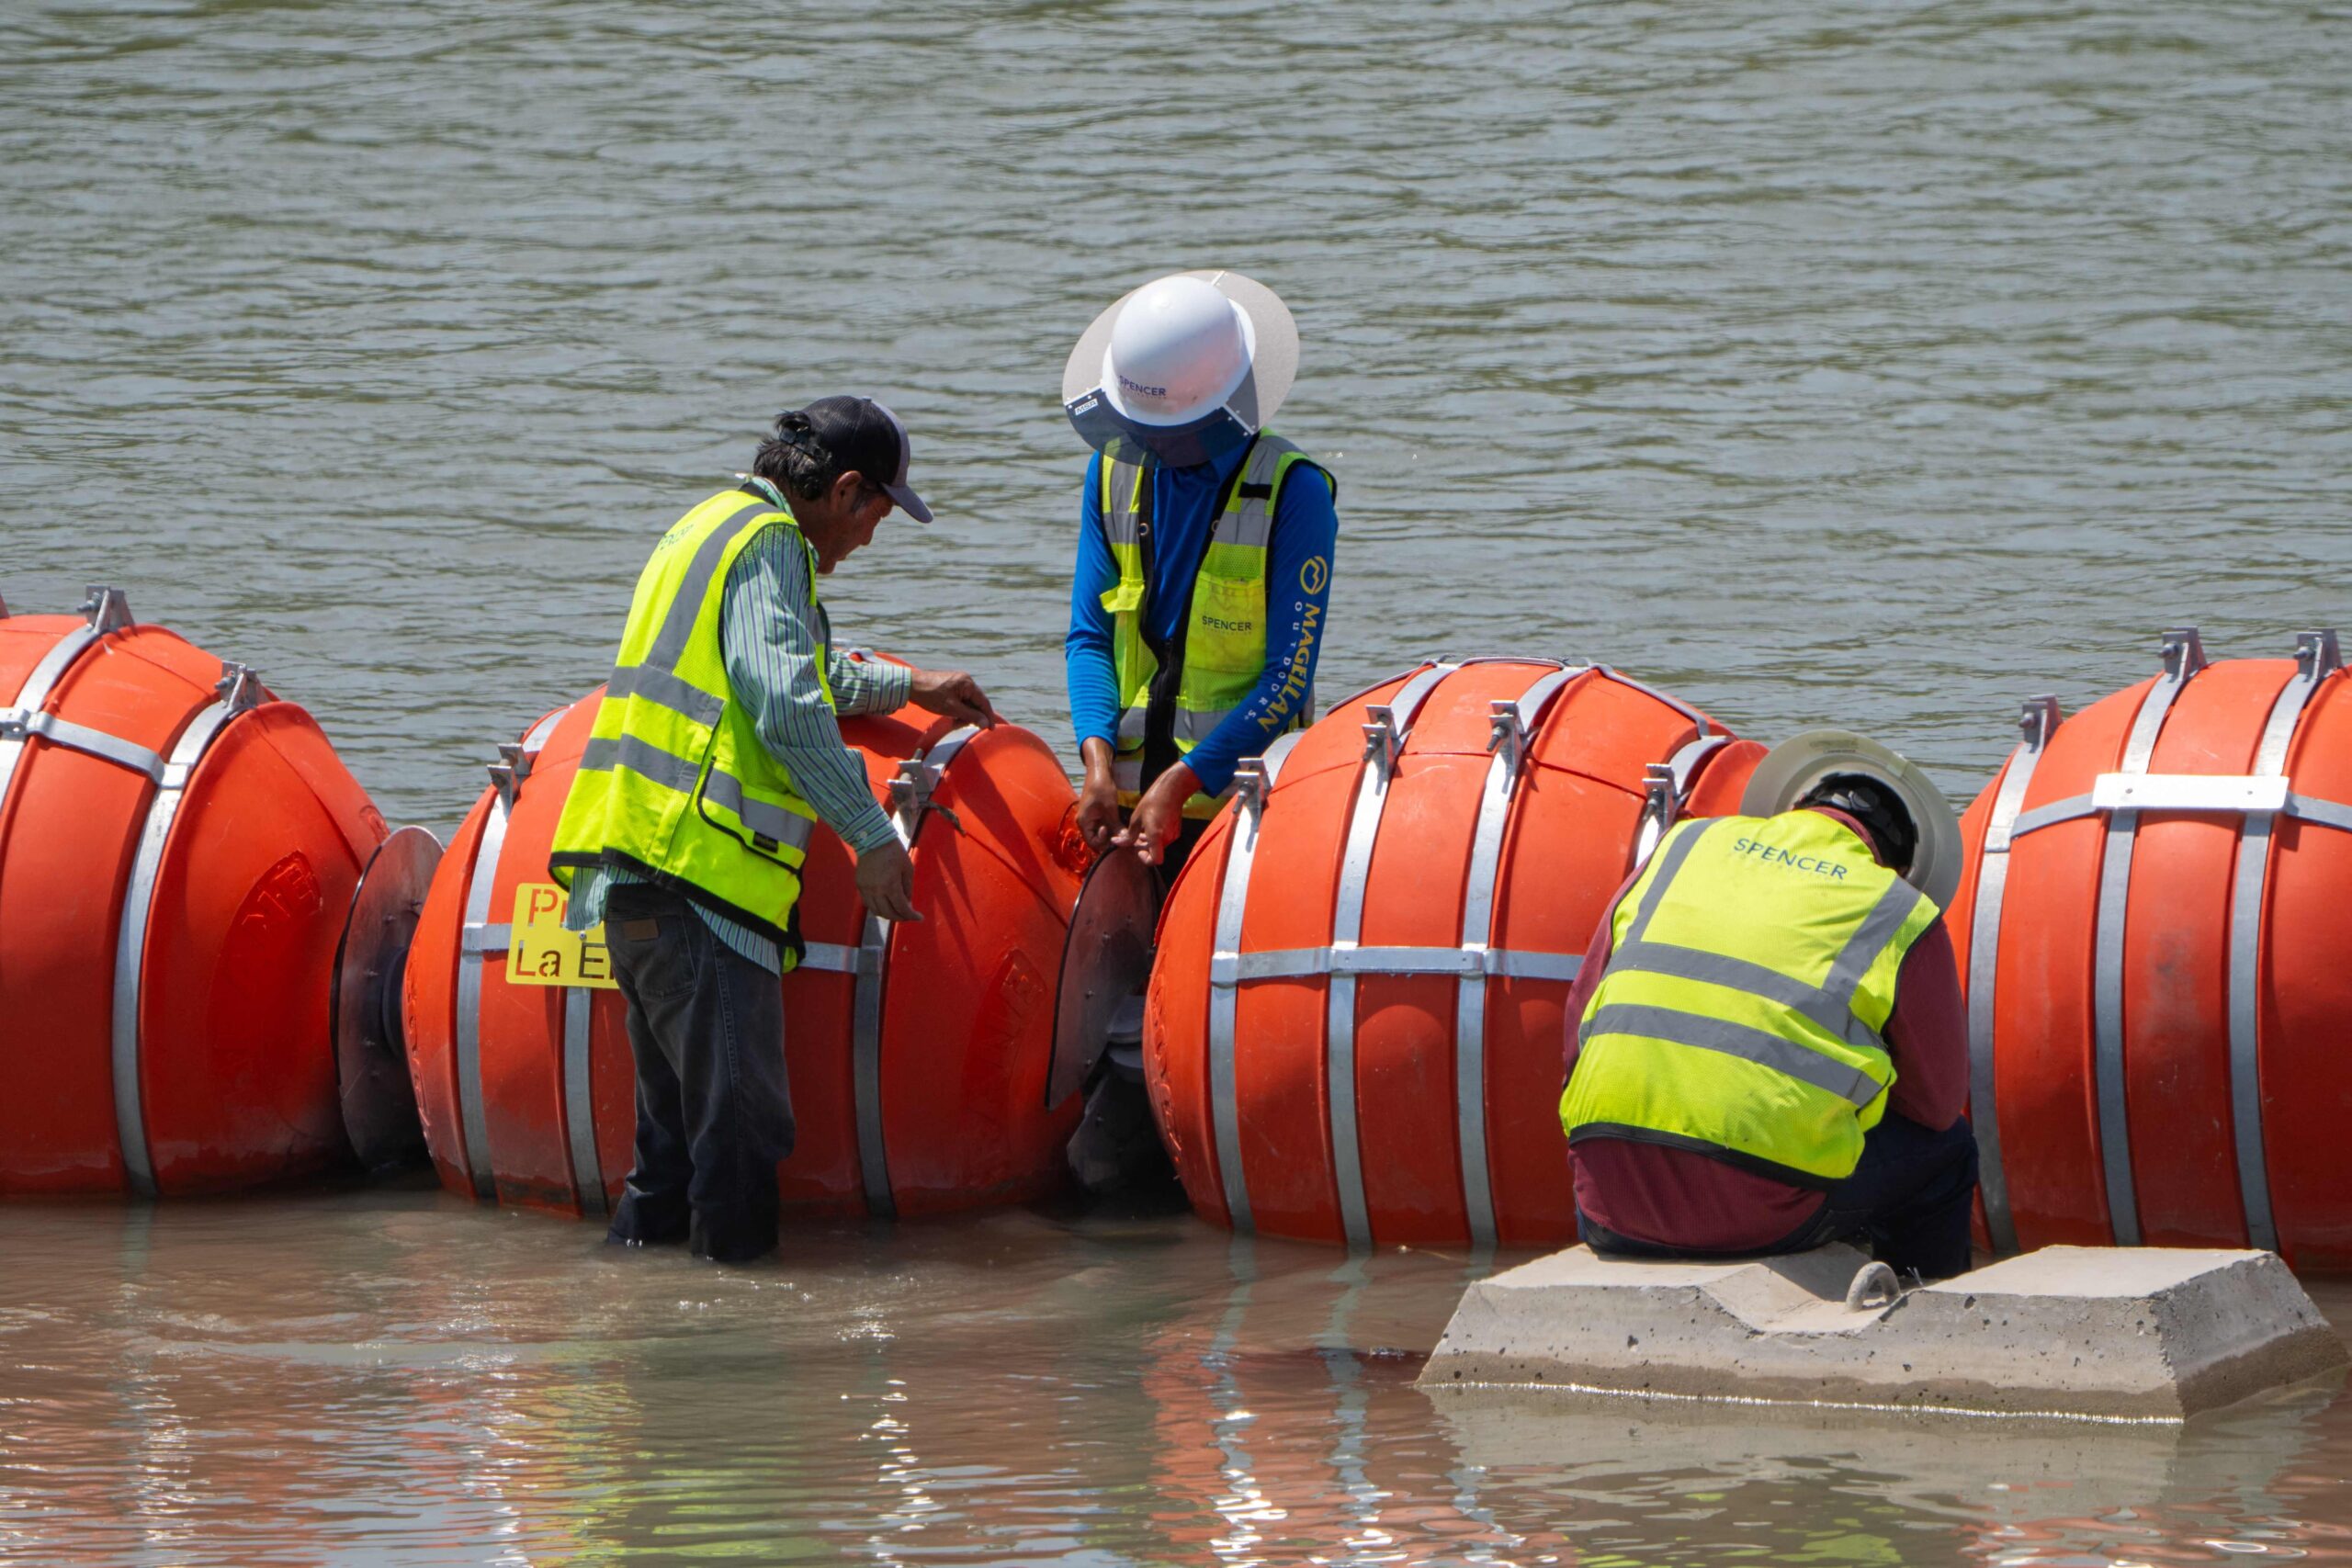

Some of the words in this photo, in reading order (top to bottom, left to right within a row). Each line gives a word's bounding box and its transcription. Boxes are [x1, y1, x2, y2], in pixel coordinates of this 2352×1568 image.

[1118, 374, 1168, 397] SPENCER
[1202, 615, 1253, 632] SPENCER
[1248, 601, 1303, 718] OUTDOORS
[1257, 602, 1321, 733] MAGELLAN
[1733, 837, 1849, 881] SPENCER
[514, 940, 562, 978] La
[578, 942, 615, 980] E
